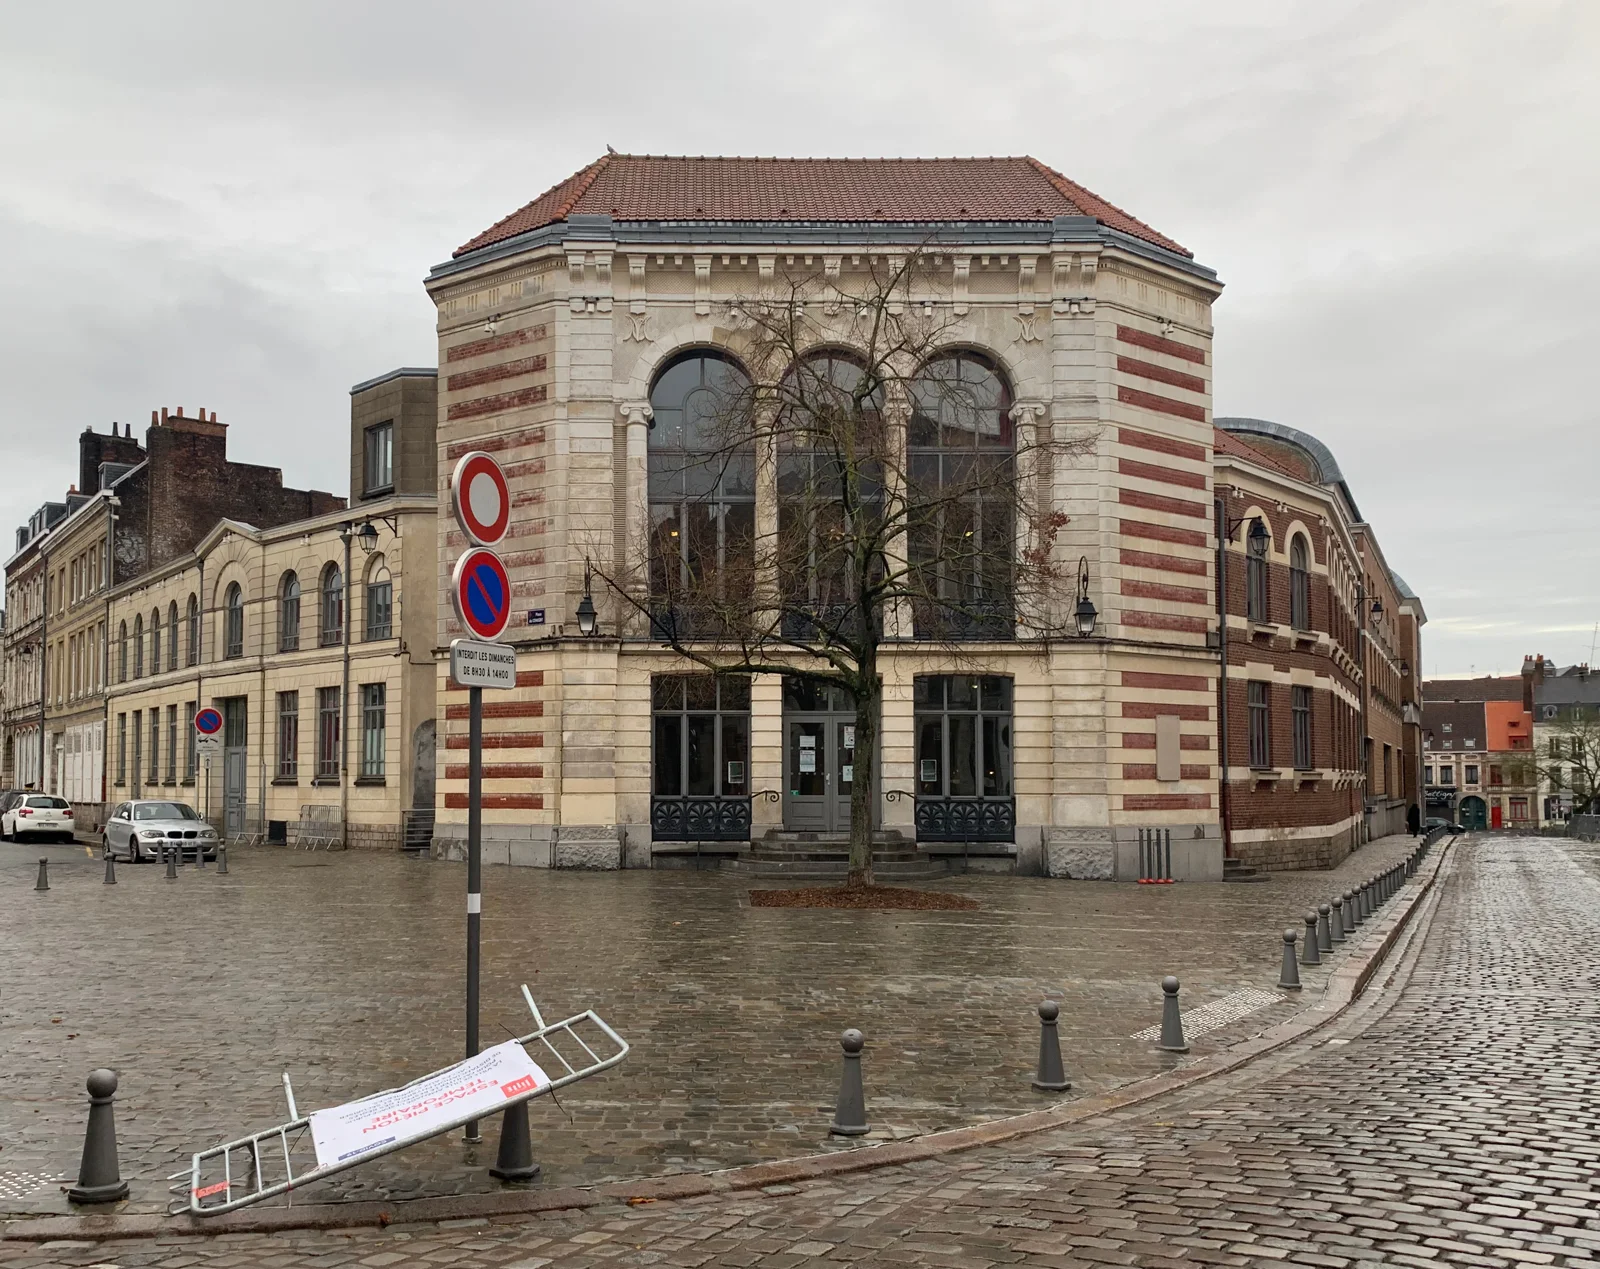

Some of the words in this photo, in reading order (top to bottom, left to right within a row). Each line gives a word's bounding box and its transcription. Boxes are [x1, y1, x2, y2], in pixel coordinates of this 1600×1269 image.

[457, 649, 478, 660] INTERDIT
[479, 651, 488, 661] LES
[488, 653, 514, 665] DIMANCHES
[463, 665, 470, 675] DE
[471, 666, 486, 677] 8H30
[487, 666, 491, 678] À
[492, 668, 509, 679] 14H00
[370, 1077, 485, 1123] TEMPORAIRE
[433, 1079, 499, 1108] ESPACE
[362, 1106, 429, 1134] PIÉTON
